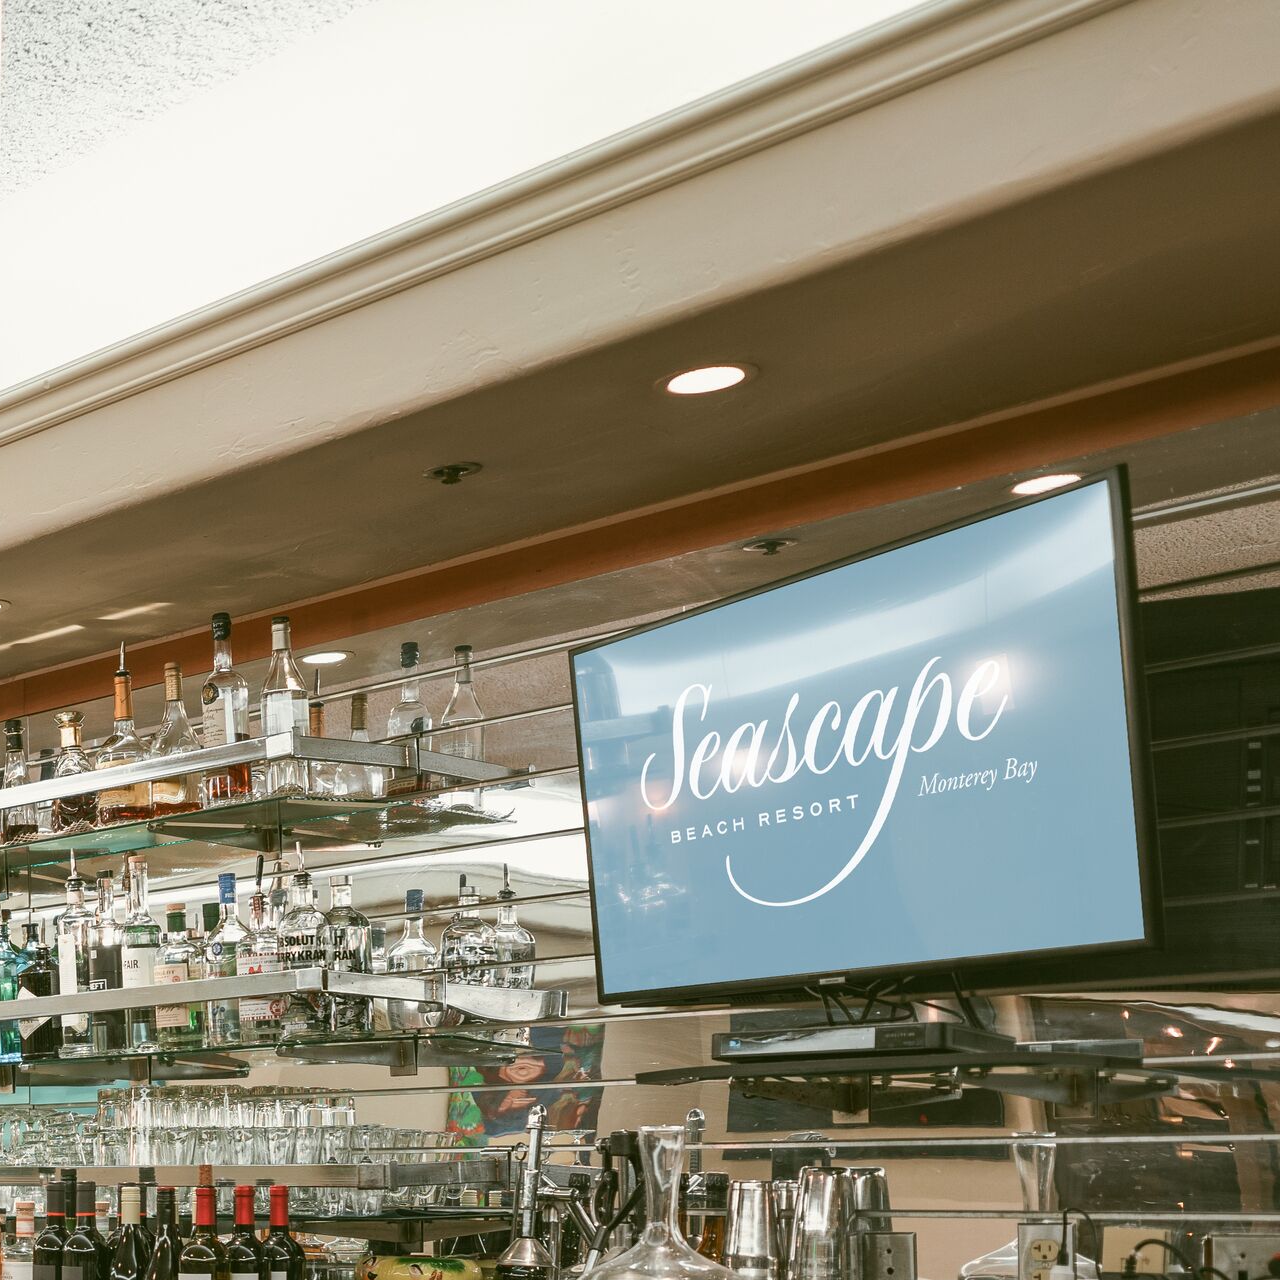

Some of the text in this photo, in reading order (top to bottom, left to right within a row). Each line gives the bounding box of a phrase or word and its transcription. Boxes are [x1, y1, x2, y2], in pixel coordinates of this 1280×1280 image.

[641, 656, 1009, 906] Seascape
[918, 757, 1038, 797] Monterey Bay
[670, 794, 861, 844] BEACH RESORT
